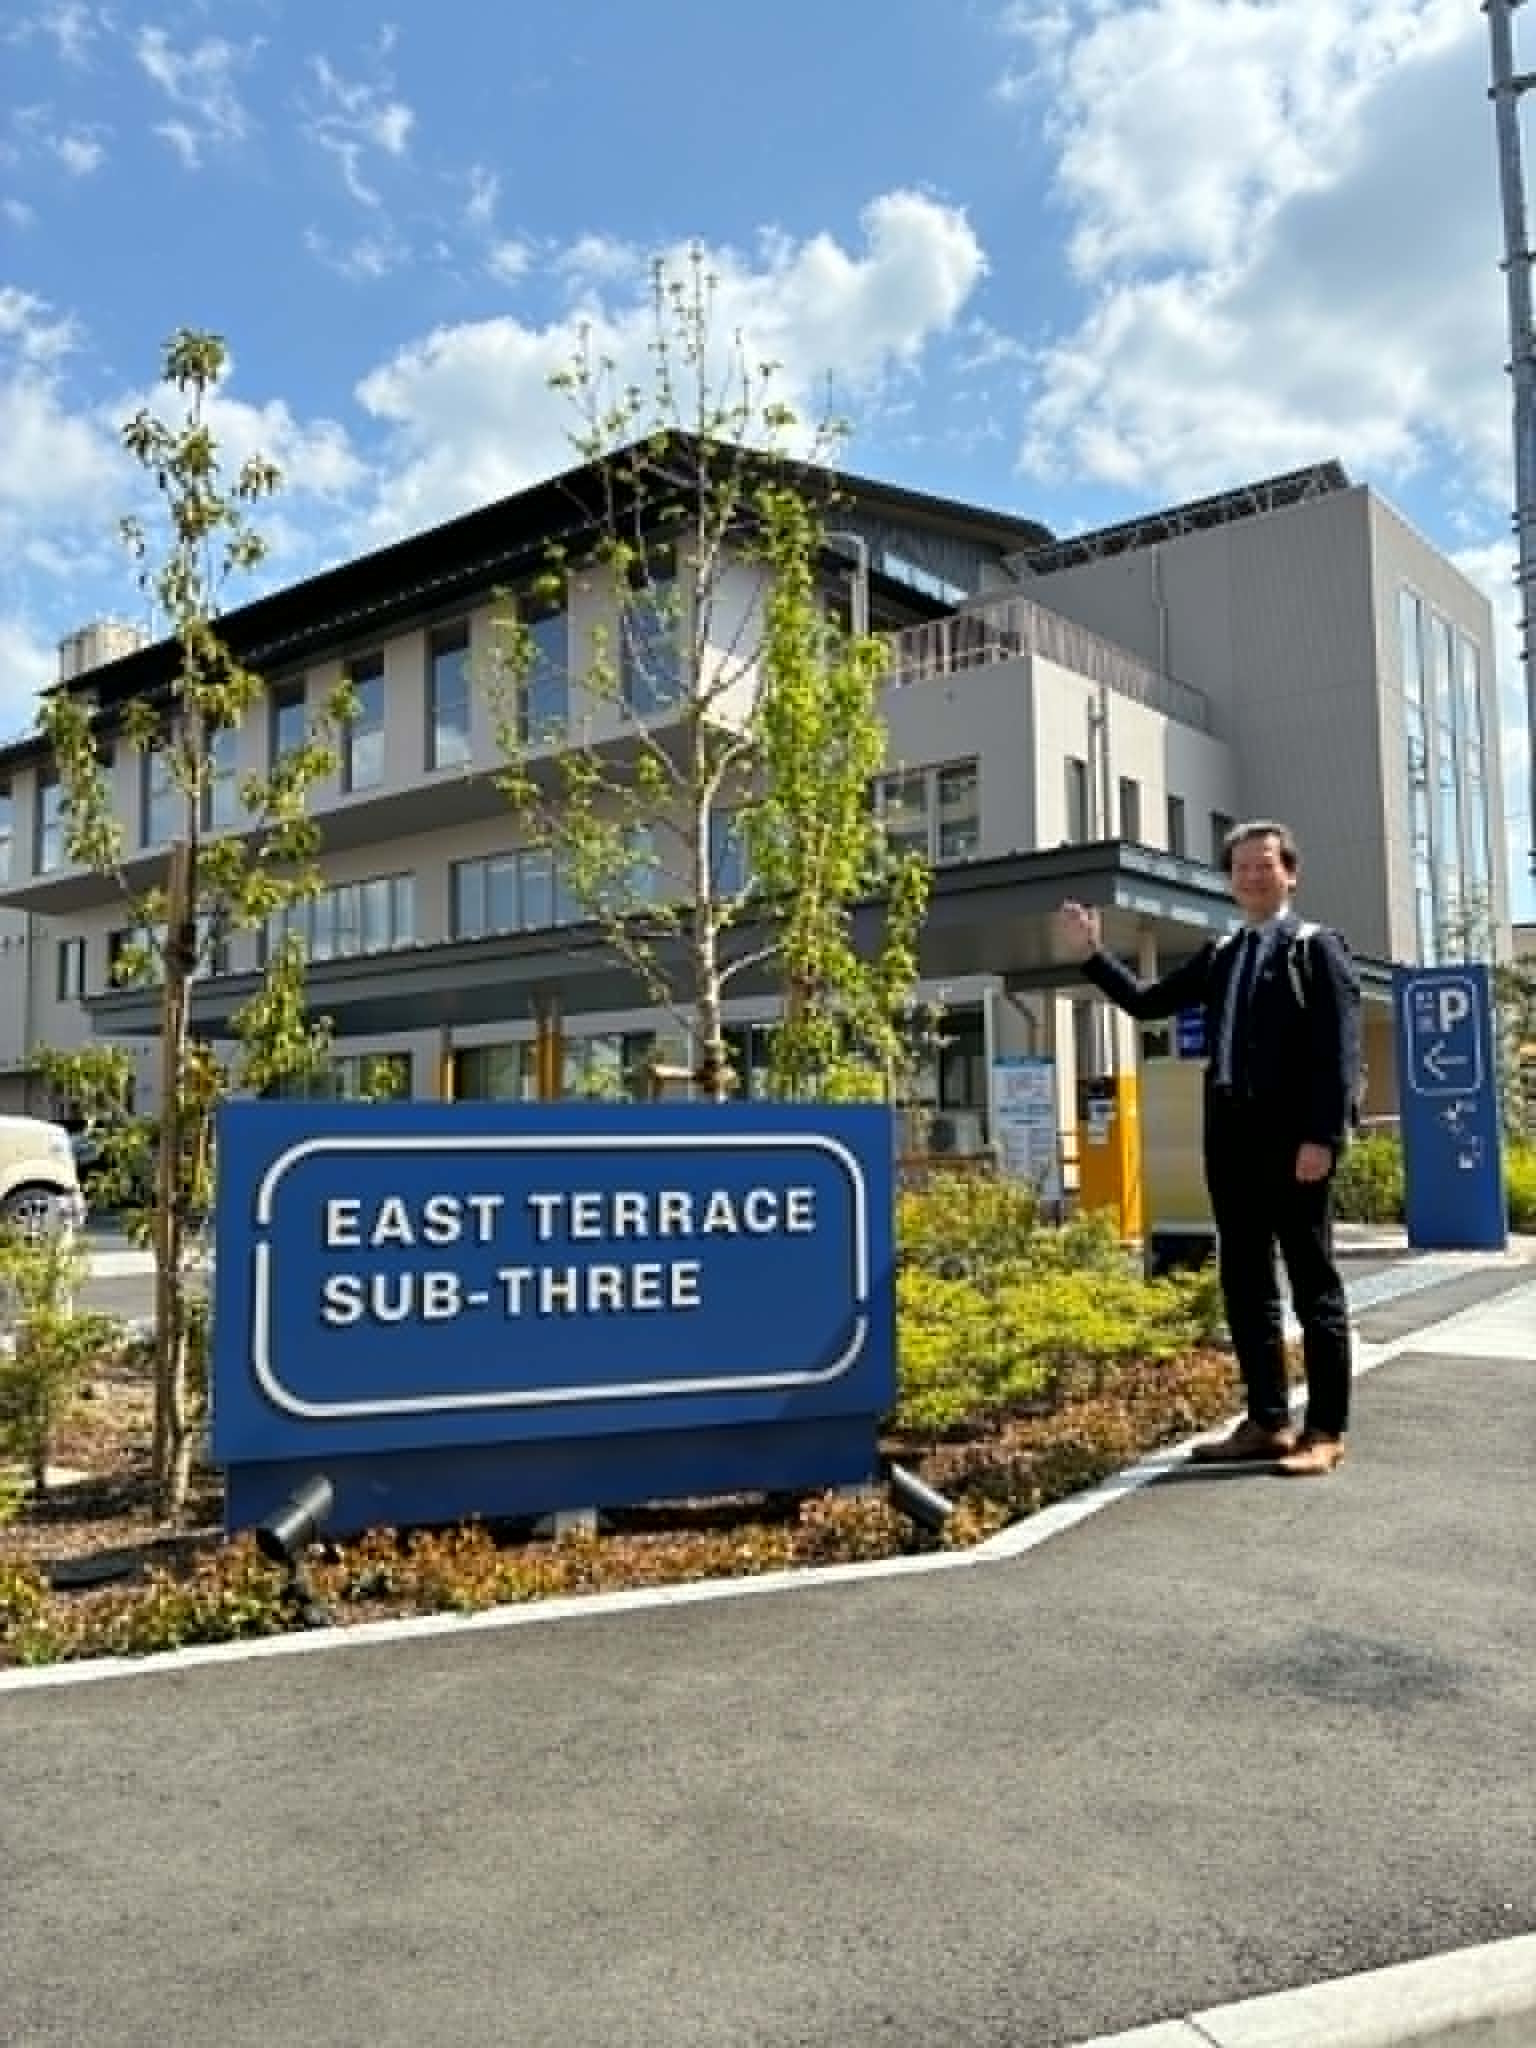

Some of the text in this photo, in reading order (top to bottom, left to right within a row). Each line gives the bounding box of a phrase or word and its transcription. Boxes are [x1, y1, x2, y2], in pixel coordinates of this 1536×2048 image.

[1439, 989, 1469, 1032] P
[326, 1187, 816, 1246] EAST TERRACE
[323, 1262, 702, 1324] SUB-THREE
